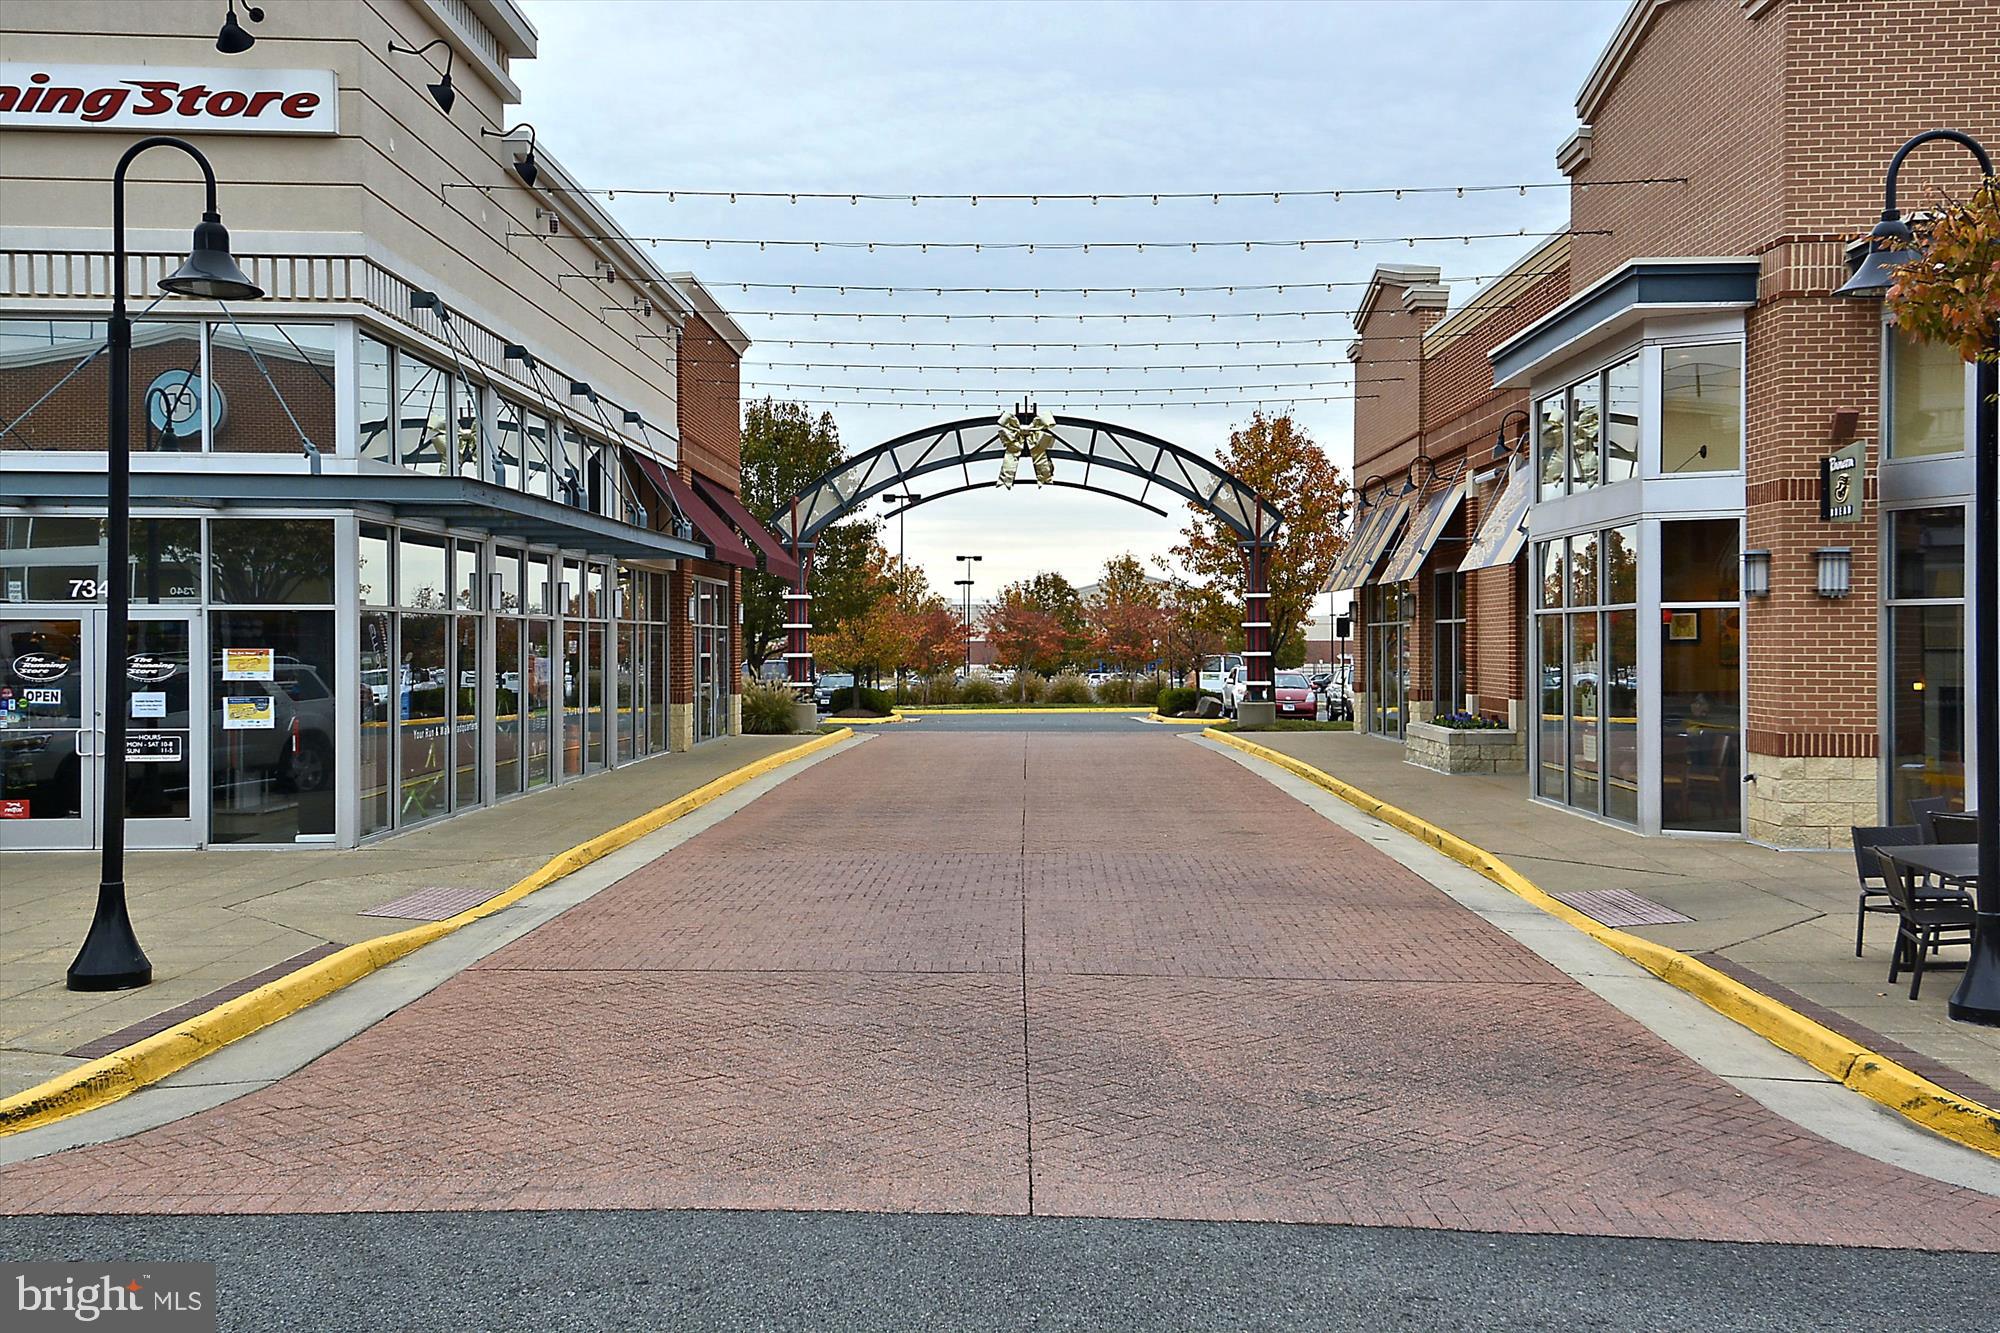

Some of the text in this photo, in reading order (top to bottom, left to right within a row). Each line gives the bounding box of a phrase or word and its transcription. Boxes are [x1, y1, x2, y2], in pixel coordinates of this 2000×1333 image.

[119, 80, 321, 119] Store
[68, 579, 108, 598] 734
[22, 661, 67, 669] Running
[129, 661, 176, 669] Running
[26, 691, 59, 702] OPEN
